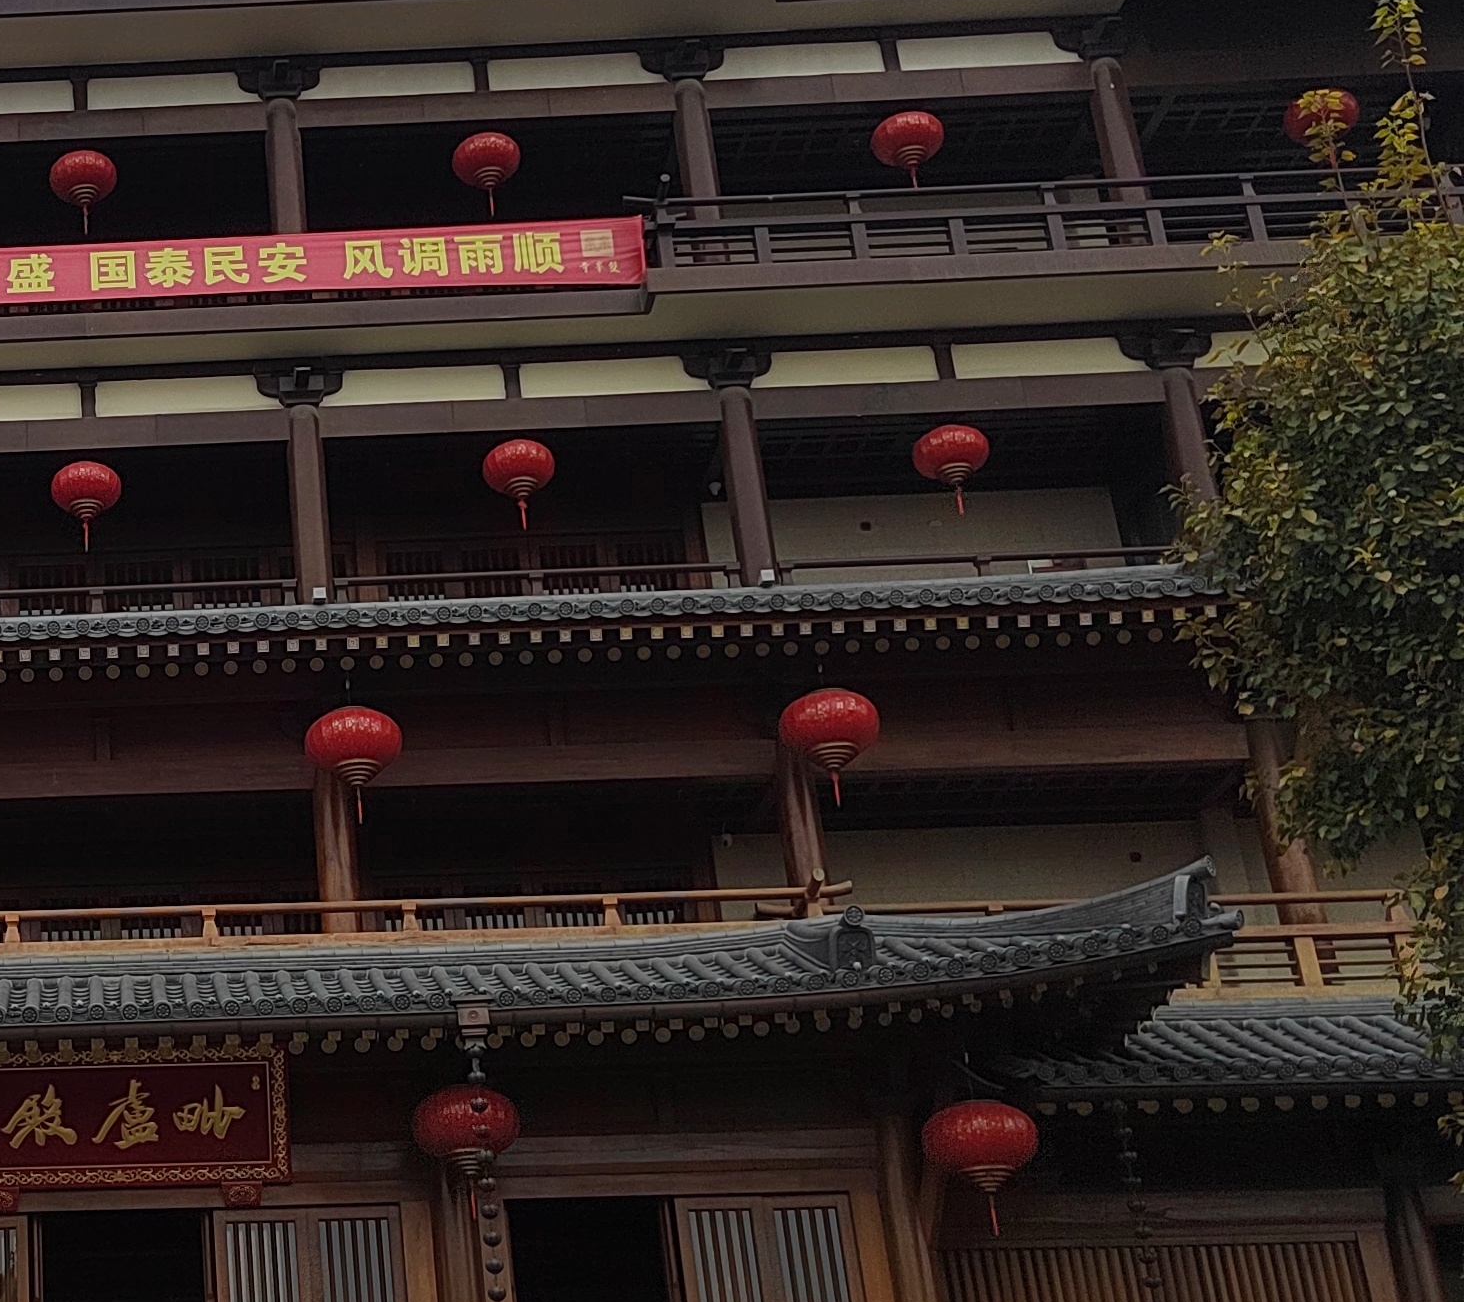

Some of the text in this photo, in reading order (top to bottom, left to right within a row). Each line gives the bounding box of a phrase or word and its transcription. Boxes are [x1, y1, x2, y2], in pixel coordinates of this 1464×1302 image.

[89, 242, 308, 291] 国泰民安
[343, 231, 565, 280] 风调雨顺
